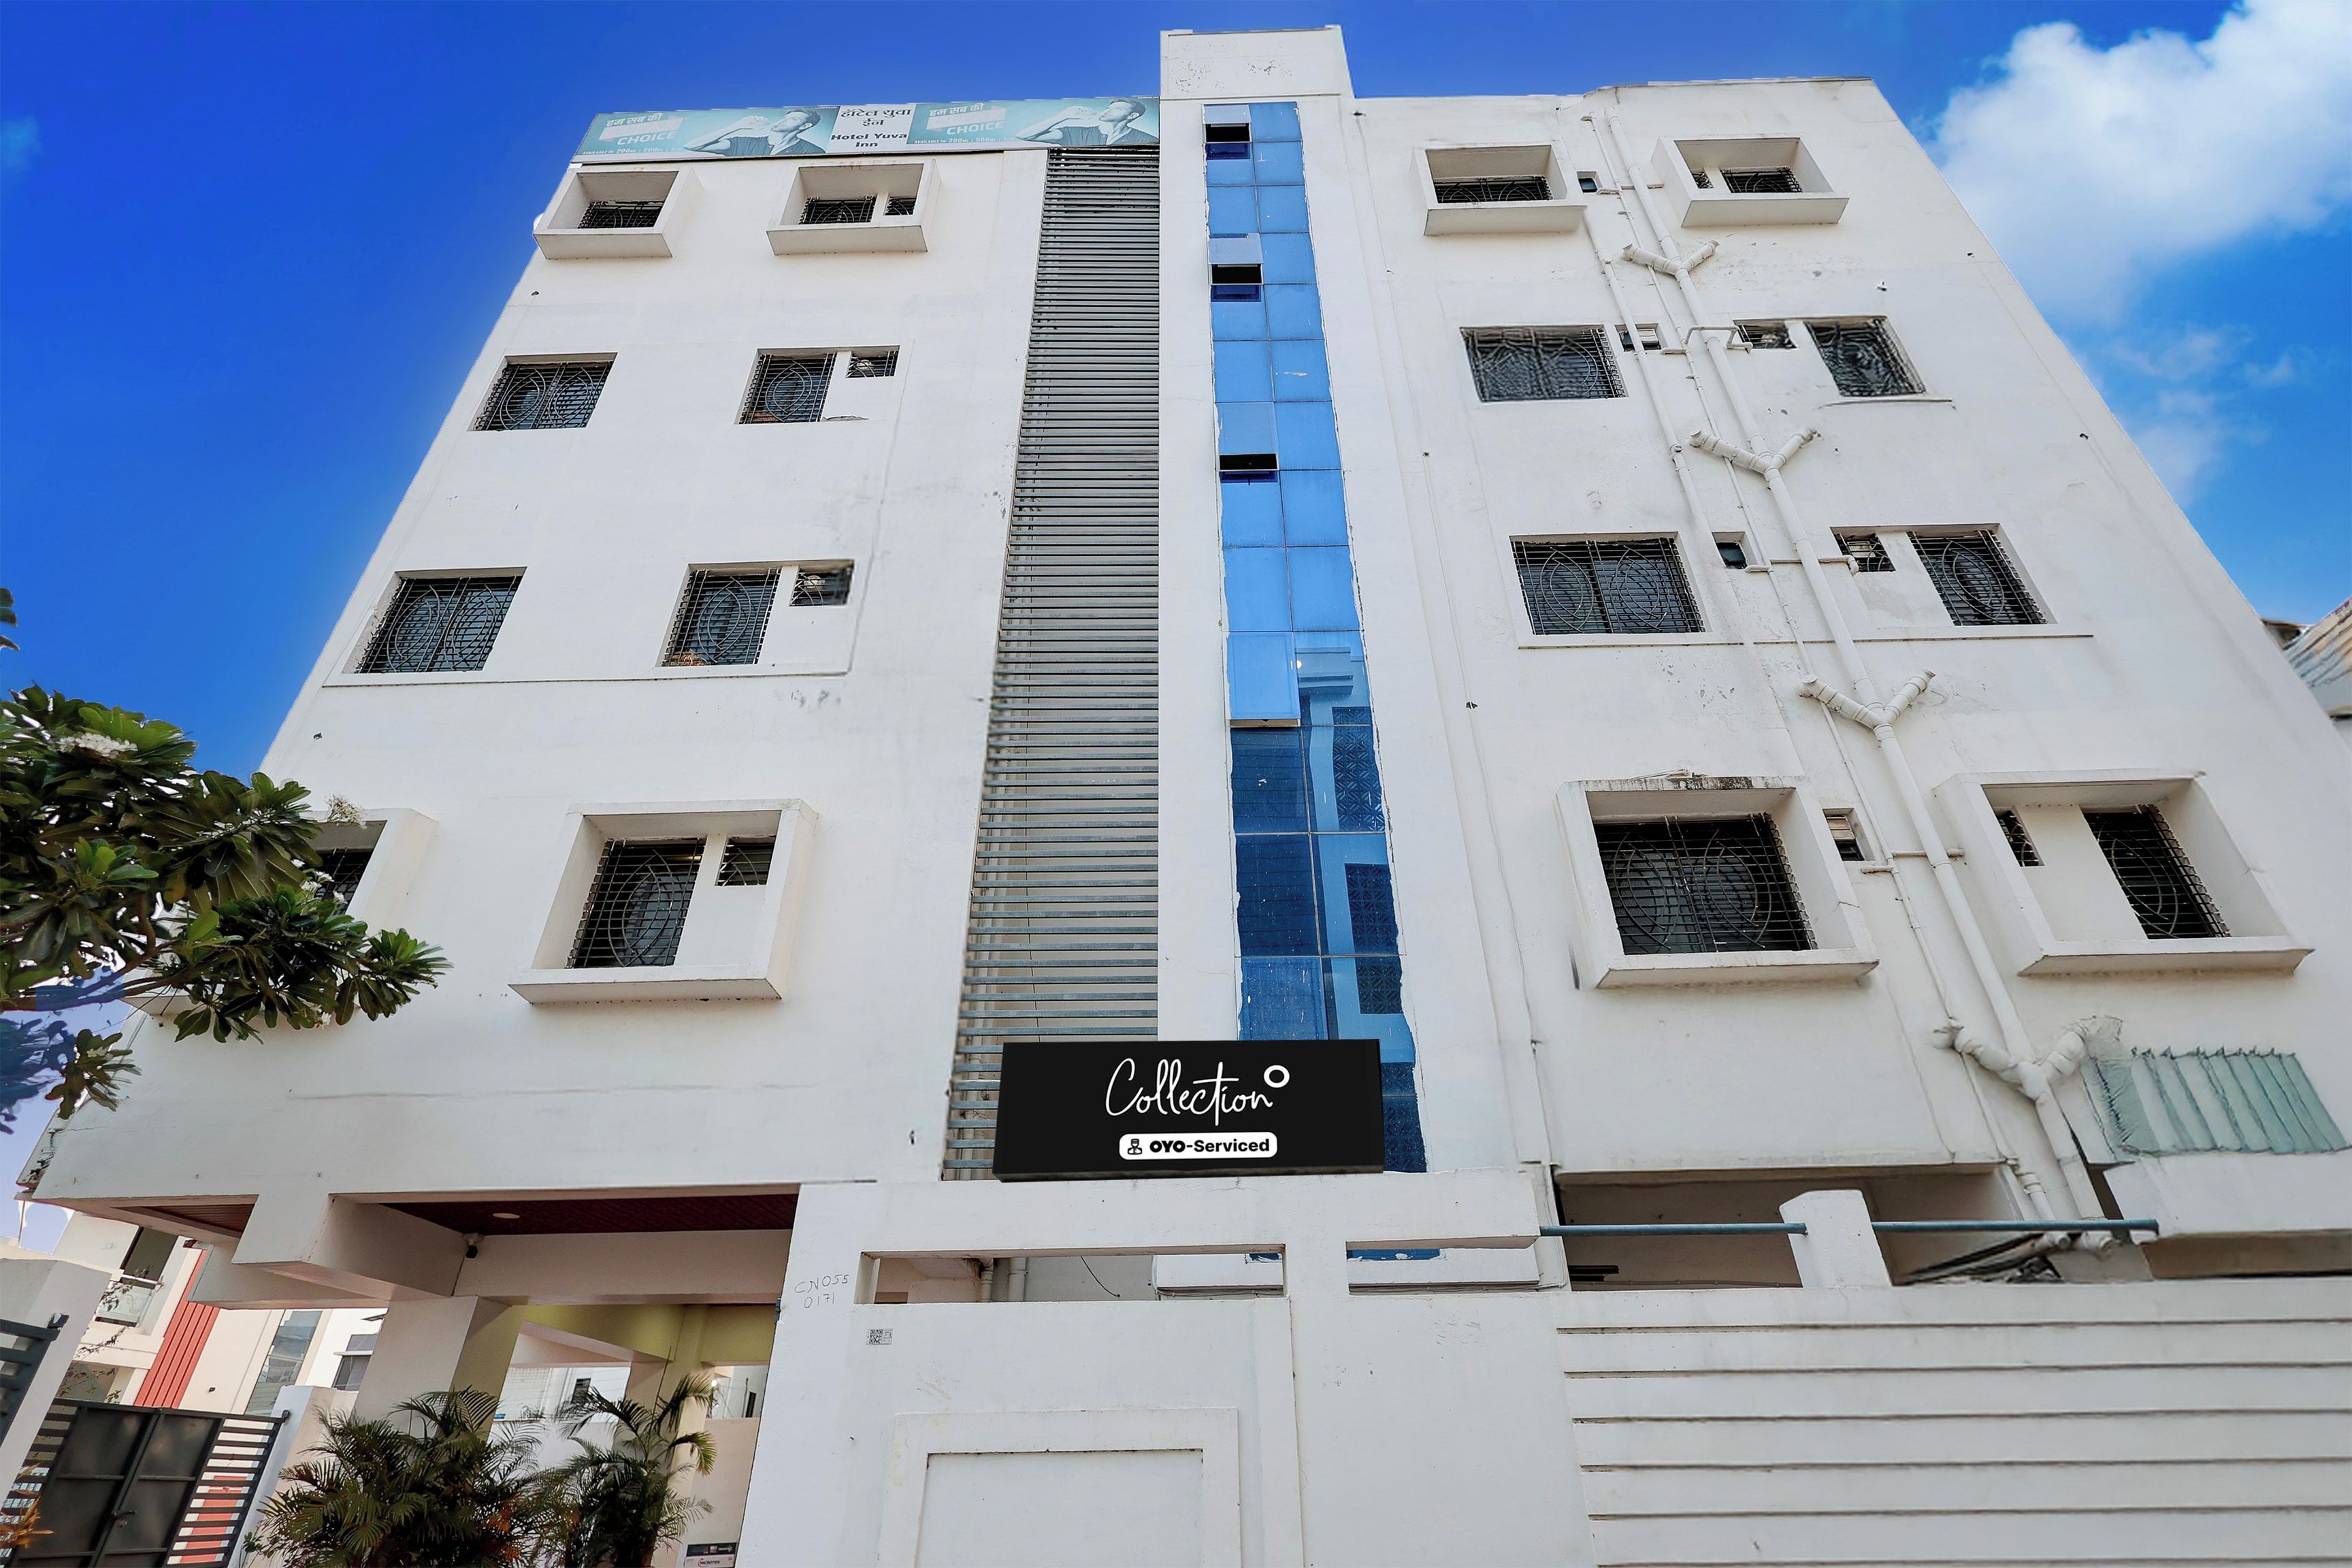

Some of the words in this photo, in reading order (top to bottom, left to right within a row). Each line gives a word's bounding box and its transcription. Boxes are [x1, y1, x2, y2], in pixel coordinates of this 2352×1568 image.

[949, 105, 969, 114] सब
[970, 102, 985, 111] की
[627, 115, 647, 125] सब
[648, 112, 663, 121] की
[946, 121, 1004, 135] CHOICE
[617, 131, 676, 145] CHOICE
[1105, 1058, 1273, 1126] Collection
[1149, 1137, 1271, 1154] OYO-Serviced
